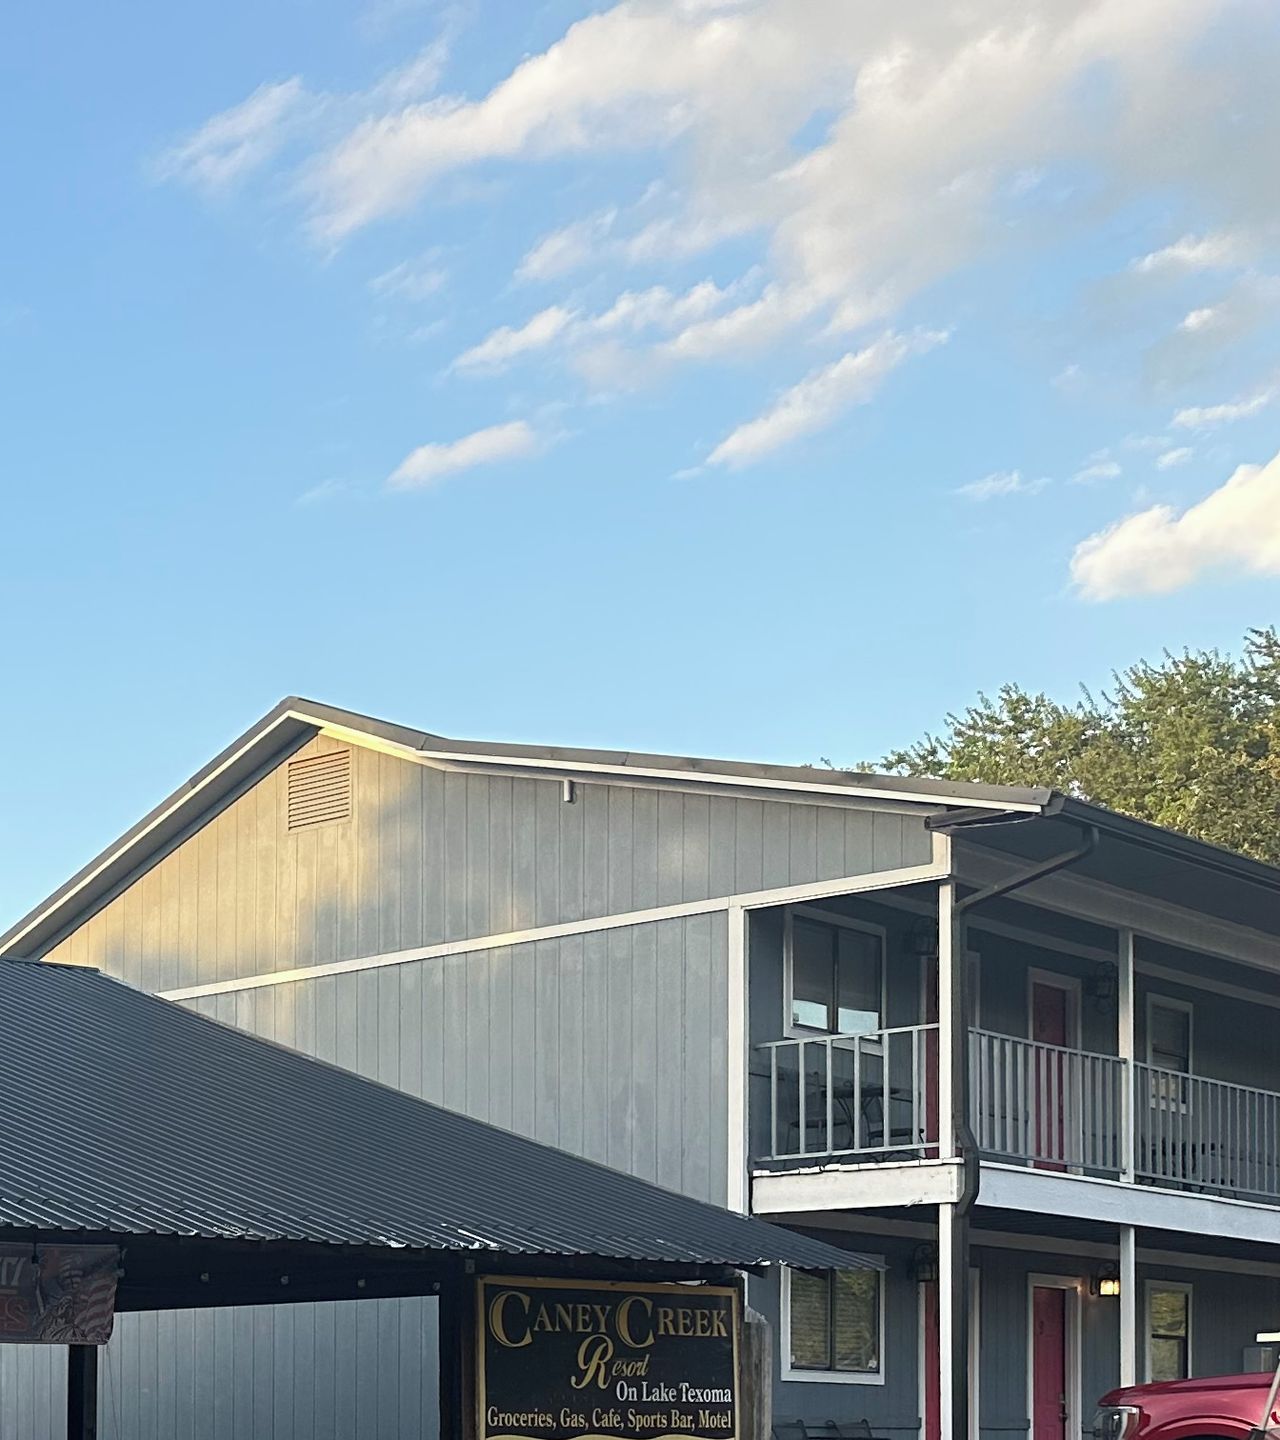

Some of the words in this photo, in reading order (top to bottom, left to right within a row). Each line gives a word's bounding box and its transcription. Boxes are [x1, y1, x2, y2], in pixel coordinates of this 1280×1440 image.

[570, 1334, 651, 1390] Resort
[616, 1380, 638, 1402] On
[641, 1381, 677, 1402] Lake
[679, 1382, 732, 1403] Texoma
[488, 1405, 557, 1430] Groceries,
[560, 1407, 590, 1430] Gas,
[592, 1407, 624, 1430] Café,
[627, 1409, 667, 1434] Sports
[670, 1409, 695, 1431] Bar,
[698, 1410, 732, 1429] Motel
